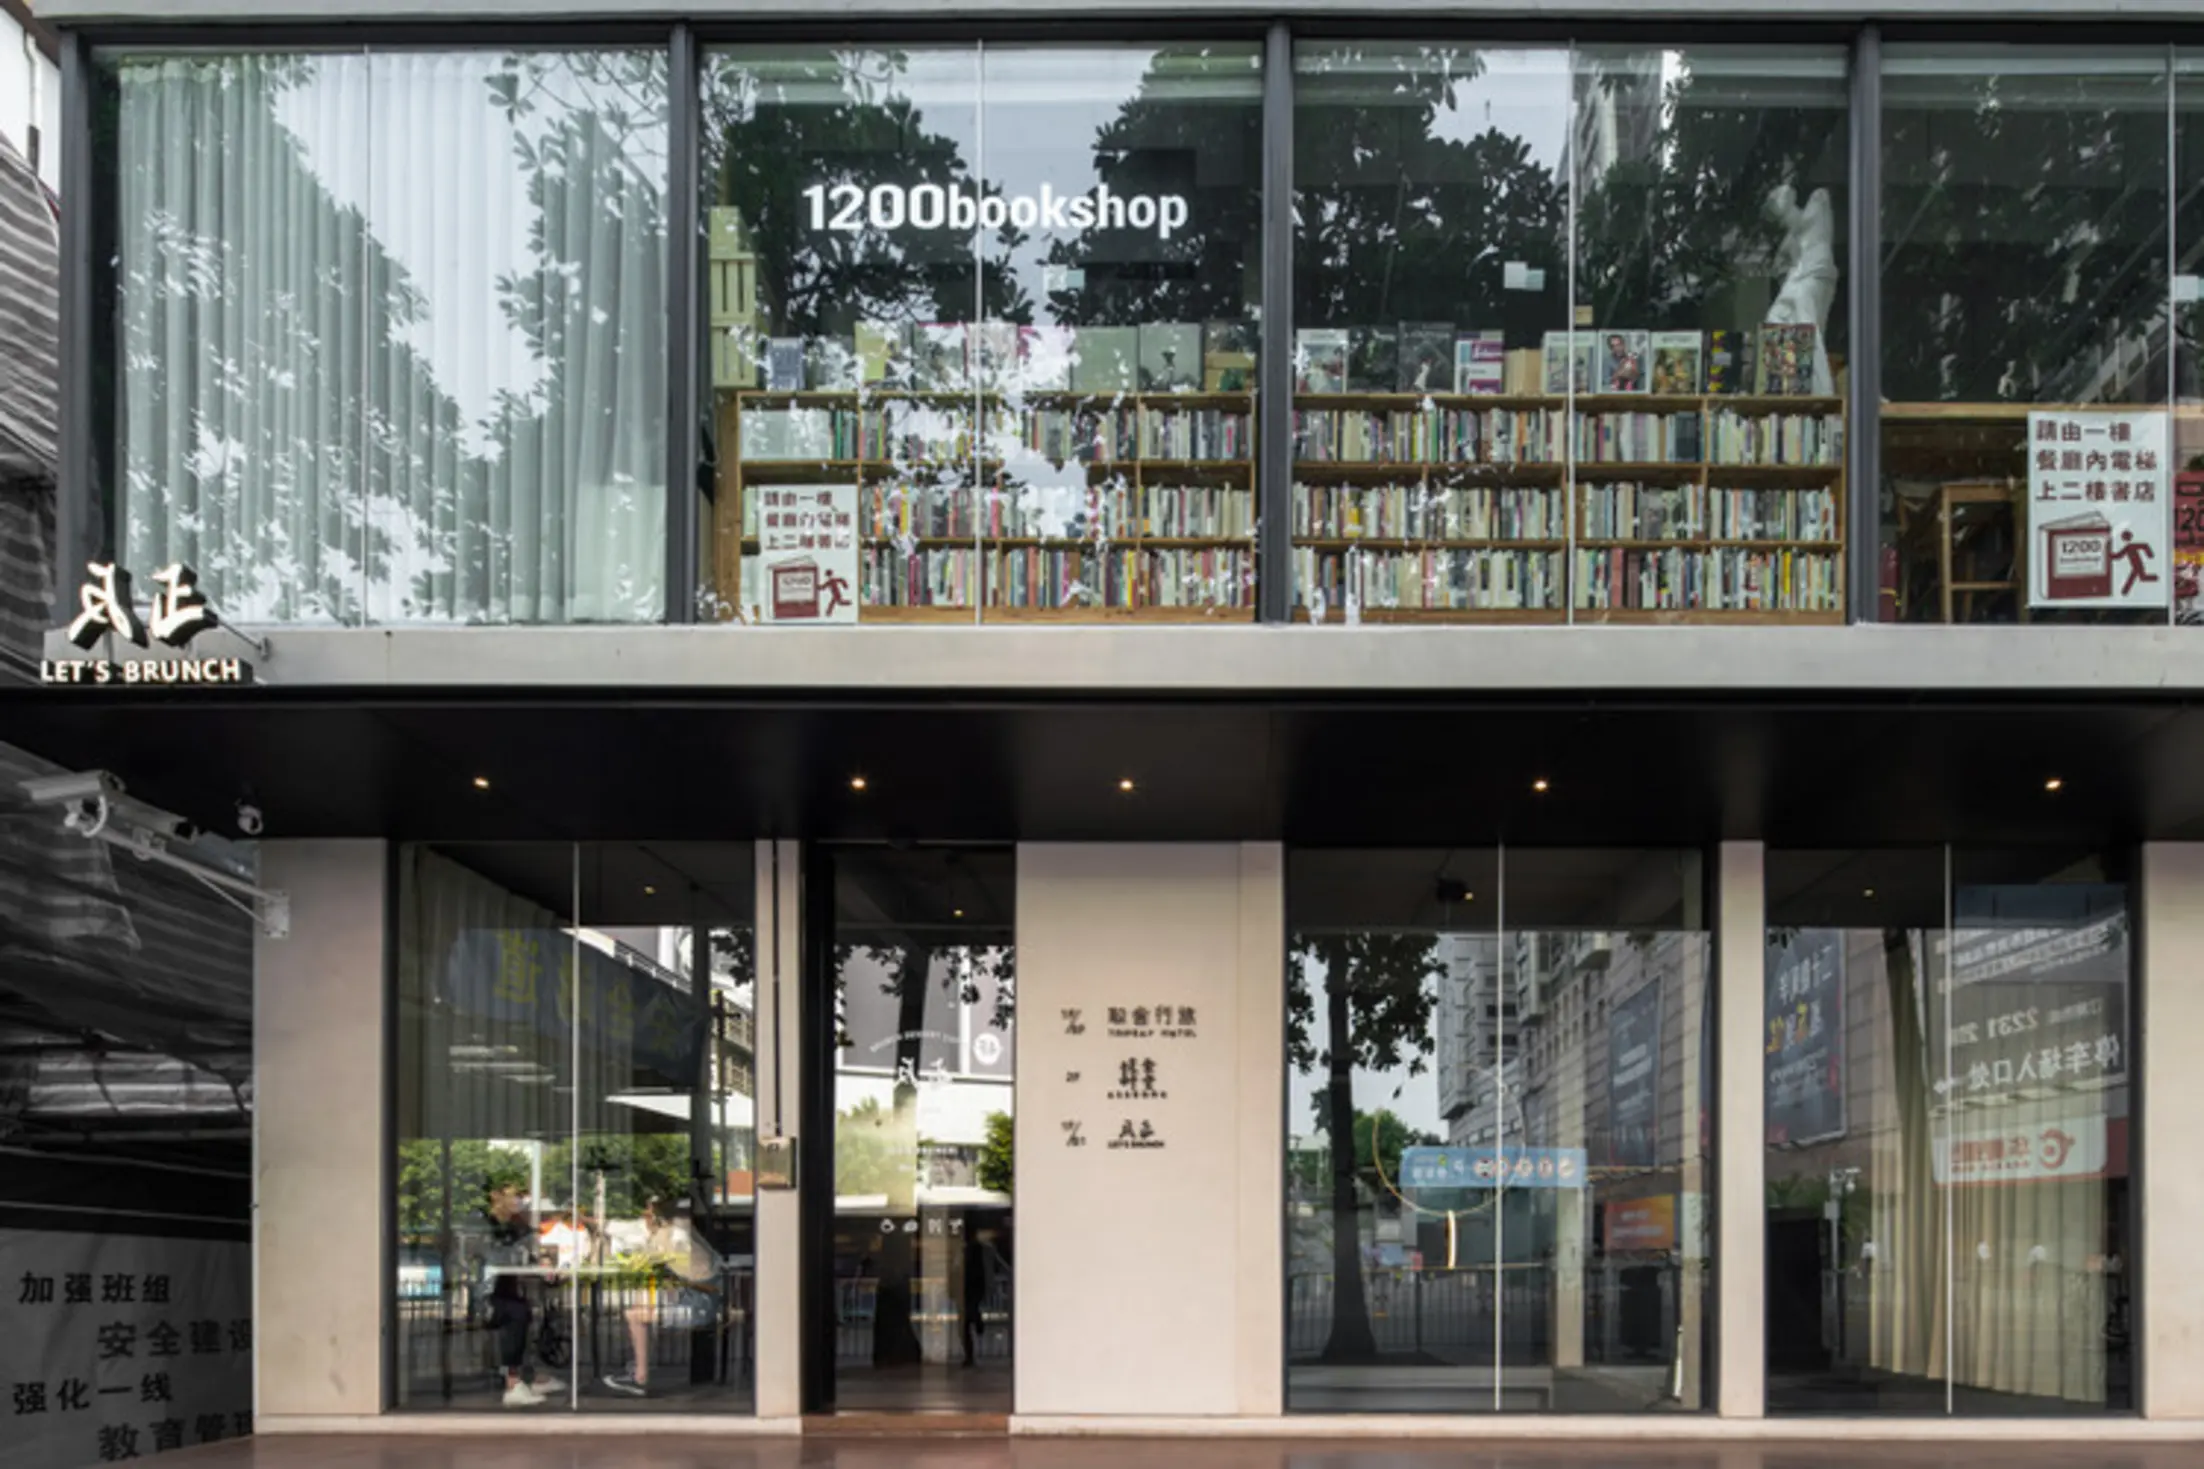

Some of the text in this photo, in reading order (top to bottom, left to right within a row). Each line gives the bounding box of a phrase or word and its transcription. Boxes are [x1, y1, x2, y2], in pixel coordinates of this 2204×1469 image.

[802, 183, 1188, 239] 1200bookshop
[41, 659, 242, 683] LET'S BRUNCH
[19, 1270, 170, 1305] 加强班组
[13, 1372, 173, 1416] 强化一线
